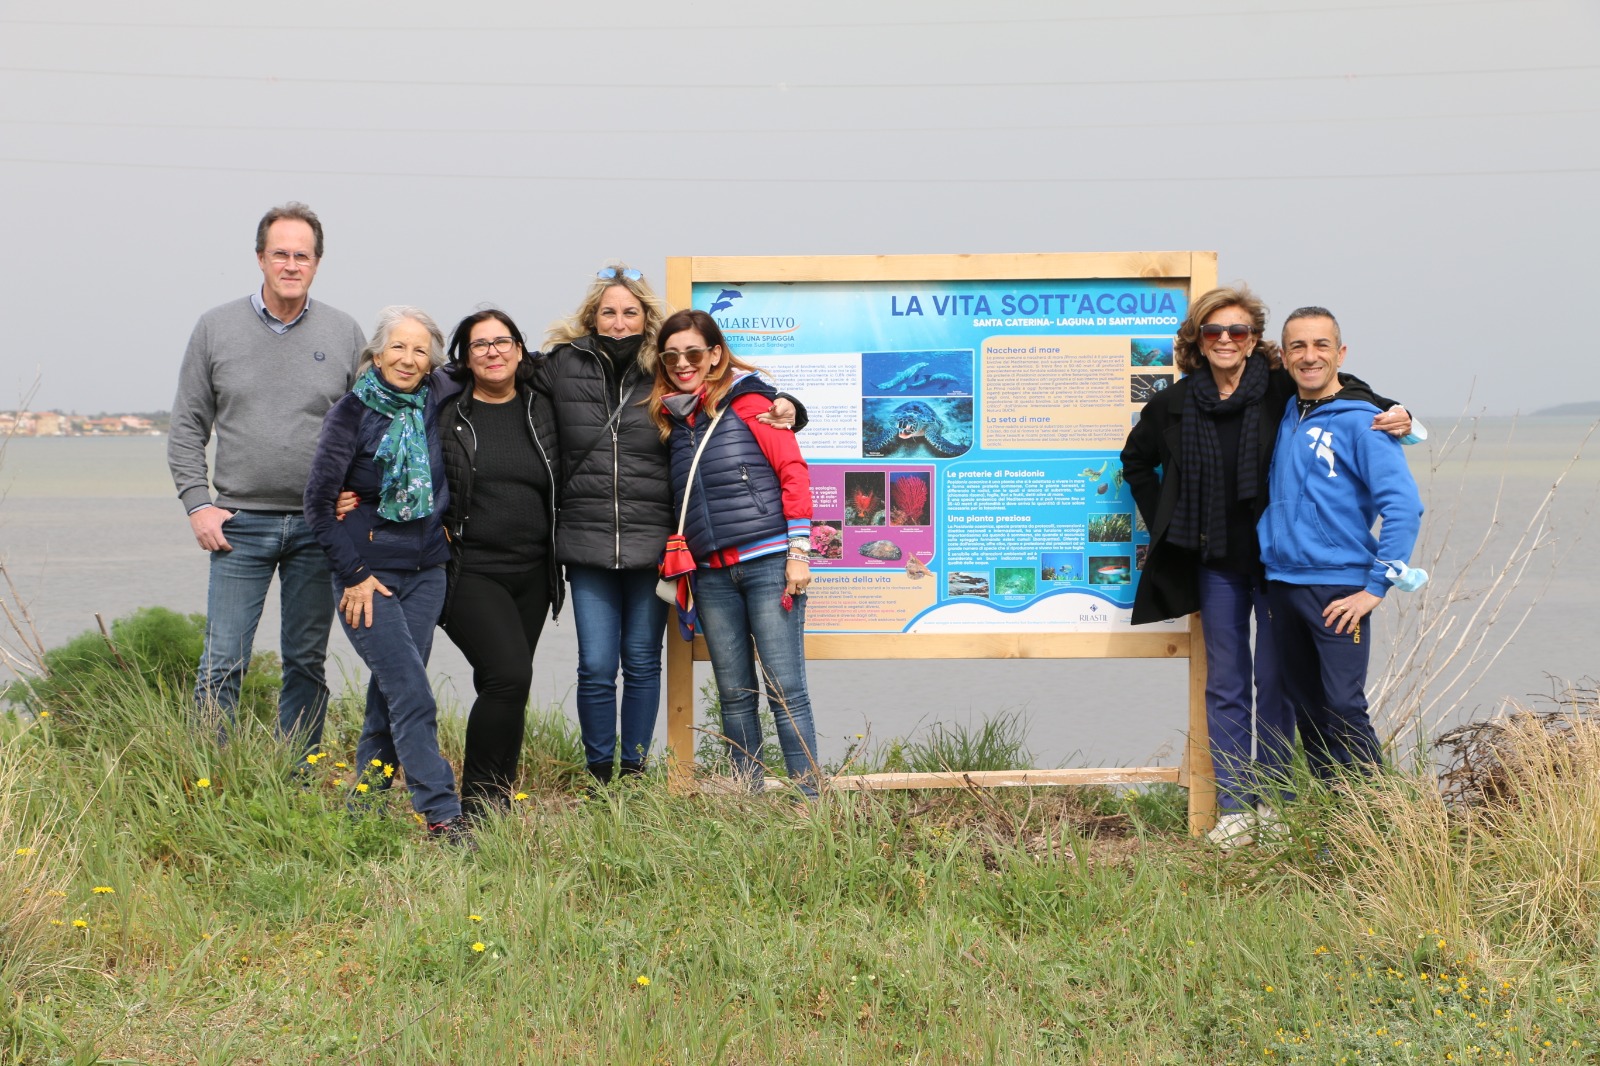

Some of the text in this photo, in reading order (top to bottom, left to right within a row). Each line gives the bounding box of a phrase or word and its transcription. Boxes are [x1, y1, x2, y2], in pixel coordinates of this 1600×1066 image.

[892, 292, 1177, 316] LA VITA SOTT'ACQUA
[717, 317, 794, 328] MAREVIVO
[973, 316, 1178, 327] SANTA CATERINA- LAGUNA DI SANT'ANTIOCO
[958, 470, 992, 479] praterie
[966, 515, 994, 523] pianta
[995, 515, 1031, 523] preziosa
